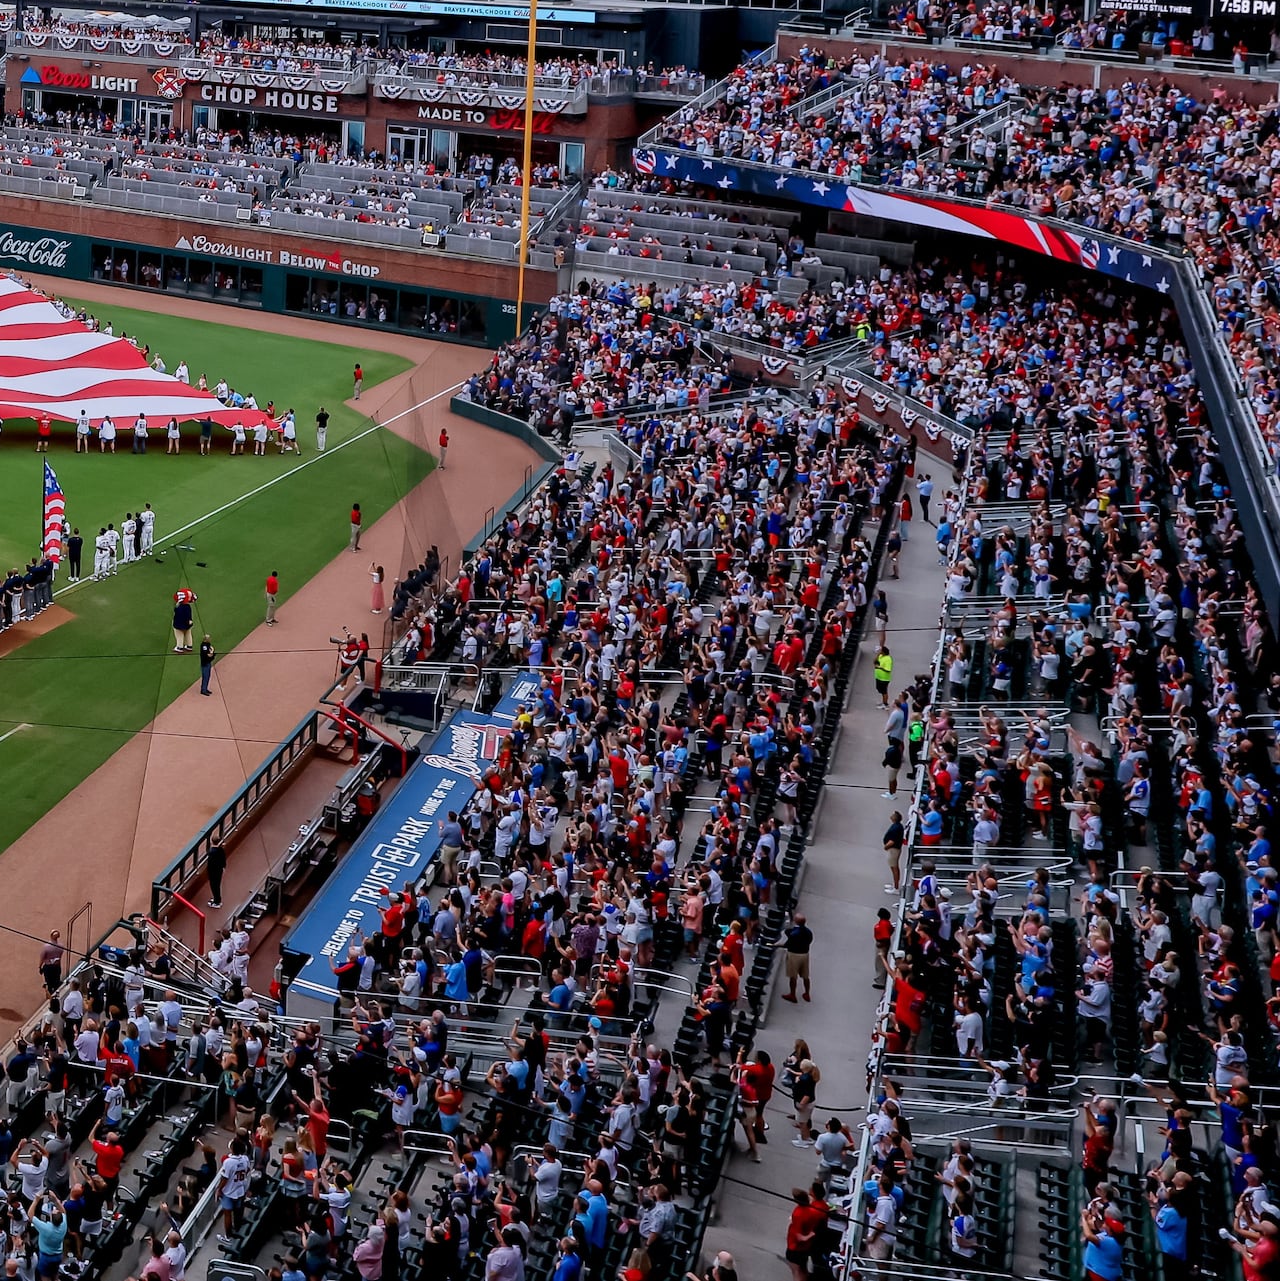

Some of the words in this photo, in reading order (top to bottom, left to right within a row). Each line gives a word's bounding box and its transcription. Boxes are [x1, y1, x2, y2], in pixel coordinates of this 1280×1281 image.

[1116, 2, 1132, 10] FLAG
[1149, 4, 1168, 12] STILL
[1169, 6, 1192, 14] THERE
[1253, 0, 1276, 15] PM
[41, 66, 90, 88] Coors
[92, 74, 138, 92] LIGHT
[201, 84, 256, 105] CHOP
[265, 91, 338, 112] HOUSE
[418, 106, 462, 122] MADE
[465, 110, 485, 123] TO
[488, 108, 557, 134] Chll
[192, 235, 234, 258] Coors
[234, 246, 272, 262] LIGHT
[280, 250, 326, 270] BELOW
[328, 260, 340, 269] THE
[342, 260, 380, 278] CHOP
[502, 304, 517, 314] 325
[419, 796, 442, 816] HOME
[432, 789, 447, 804] OF
[440, 778, 457, 795] THE
[350, 860, 401, 906] TRUIST
[396, 816, 433, 850] PARK
[319, 918, 358, 958] WELCOME
[346, 908, 364, 928] TO
